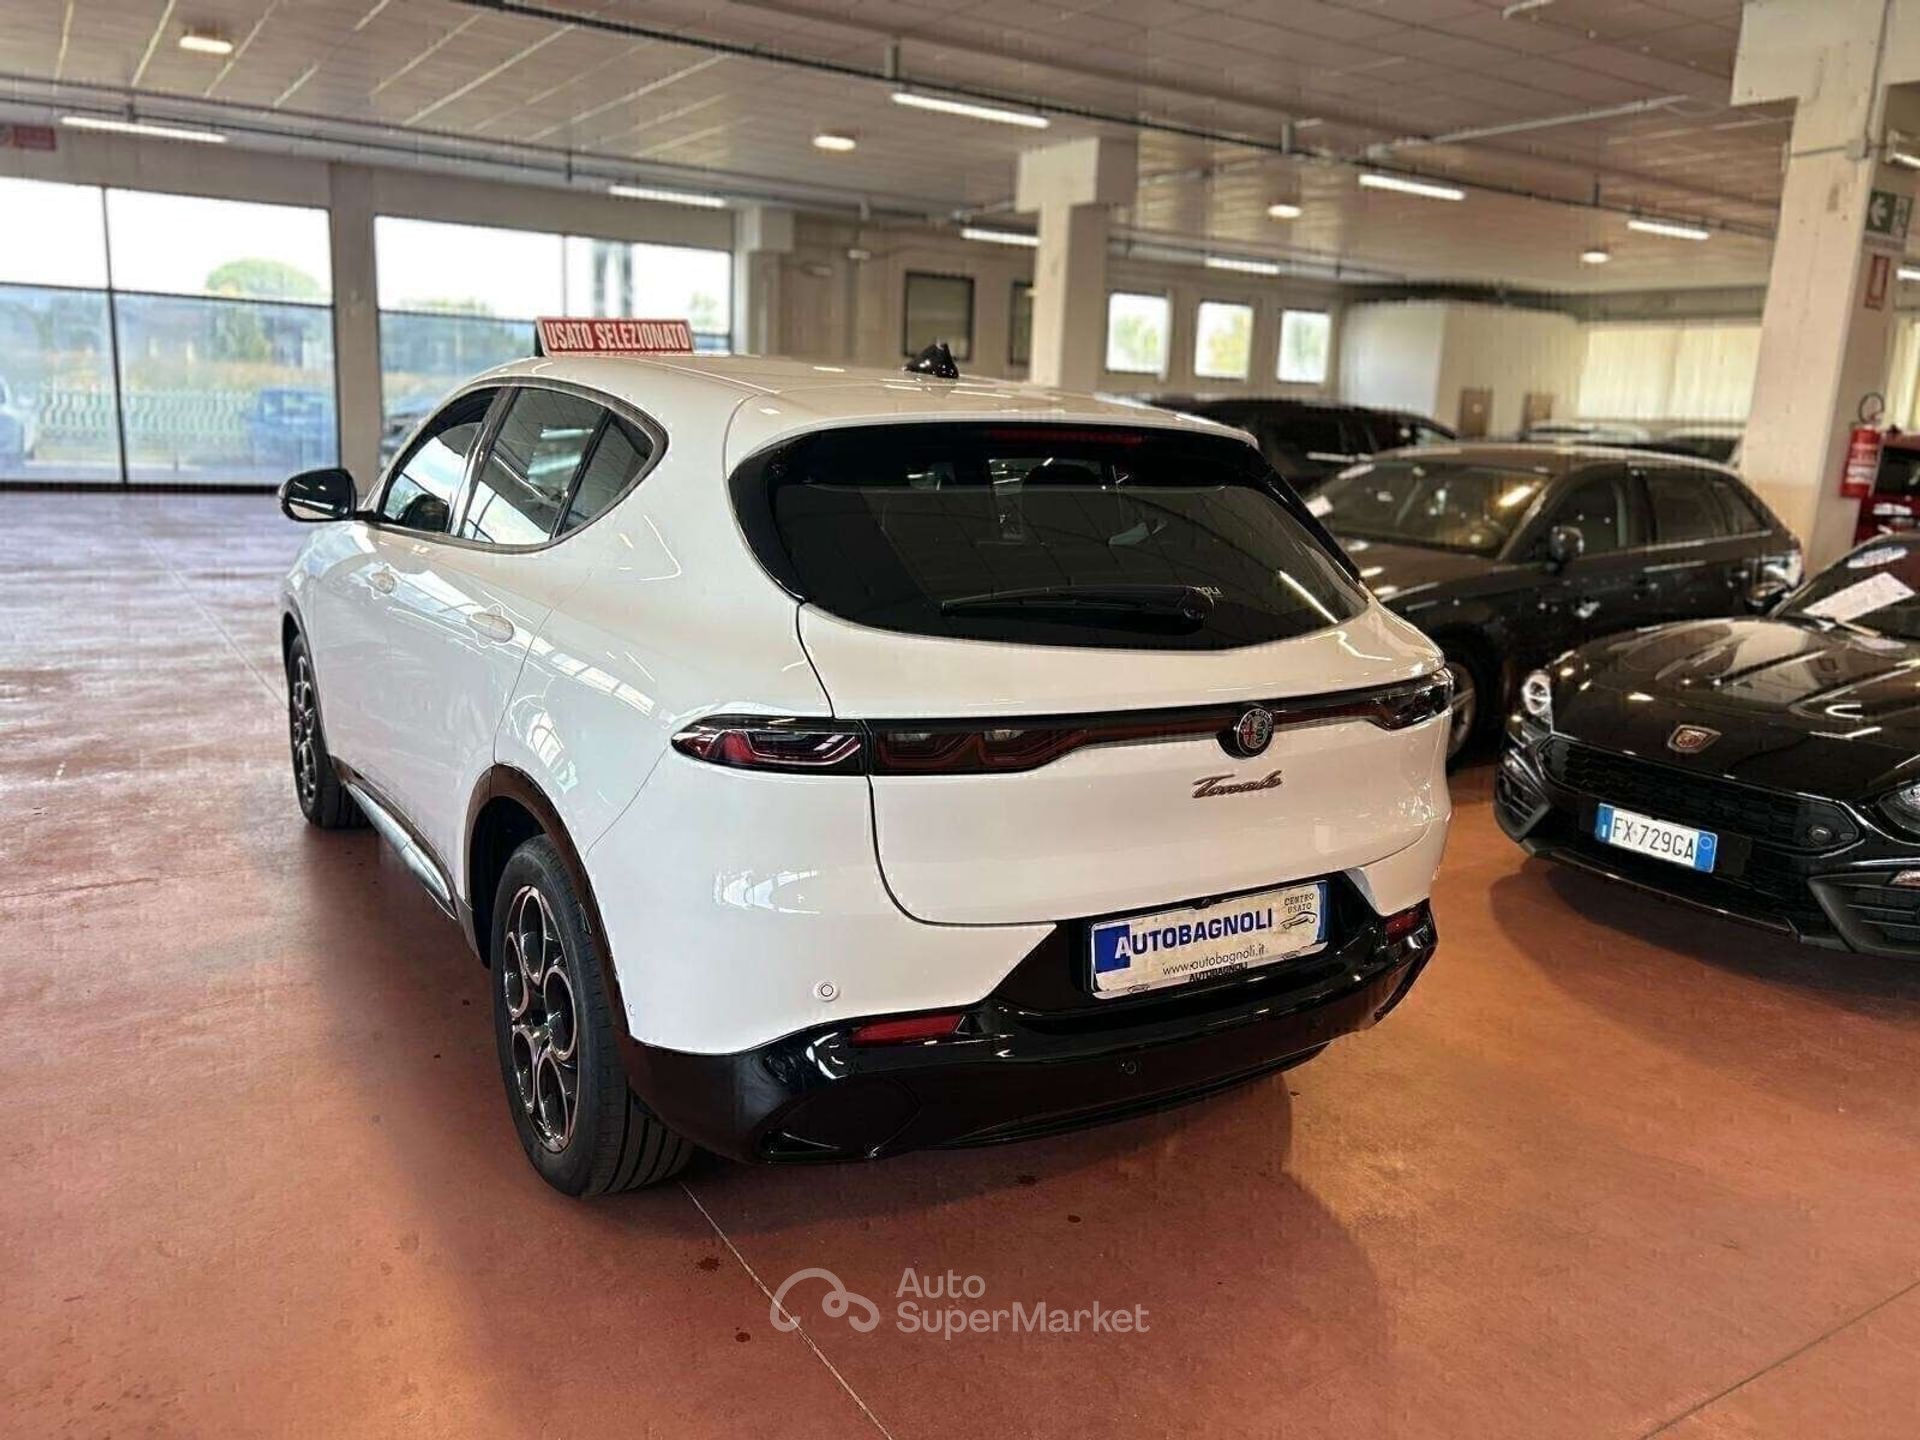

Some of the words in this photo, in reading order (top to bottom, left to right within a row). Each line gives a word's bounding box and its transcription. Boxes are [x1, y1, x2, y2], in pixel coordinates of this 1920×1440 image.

[545, 322, 594, 349] USATO
[594, 322, 690, 349] SELEZIONATO
[1284, 893, 1315, 906] CENTRO
[1287, 902, 1312, 914] USATO
[1114, 907, 1273, 960] AUTOBAGNOLI
[1162, 943, 1266, 976] www.autobagnoli.it
